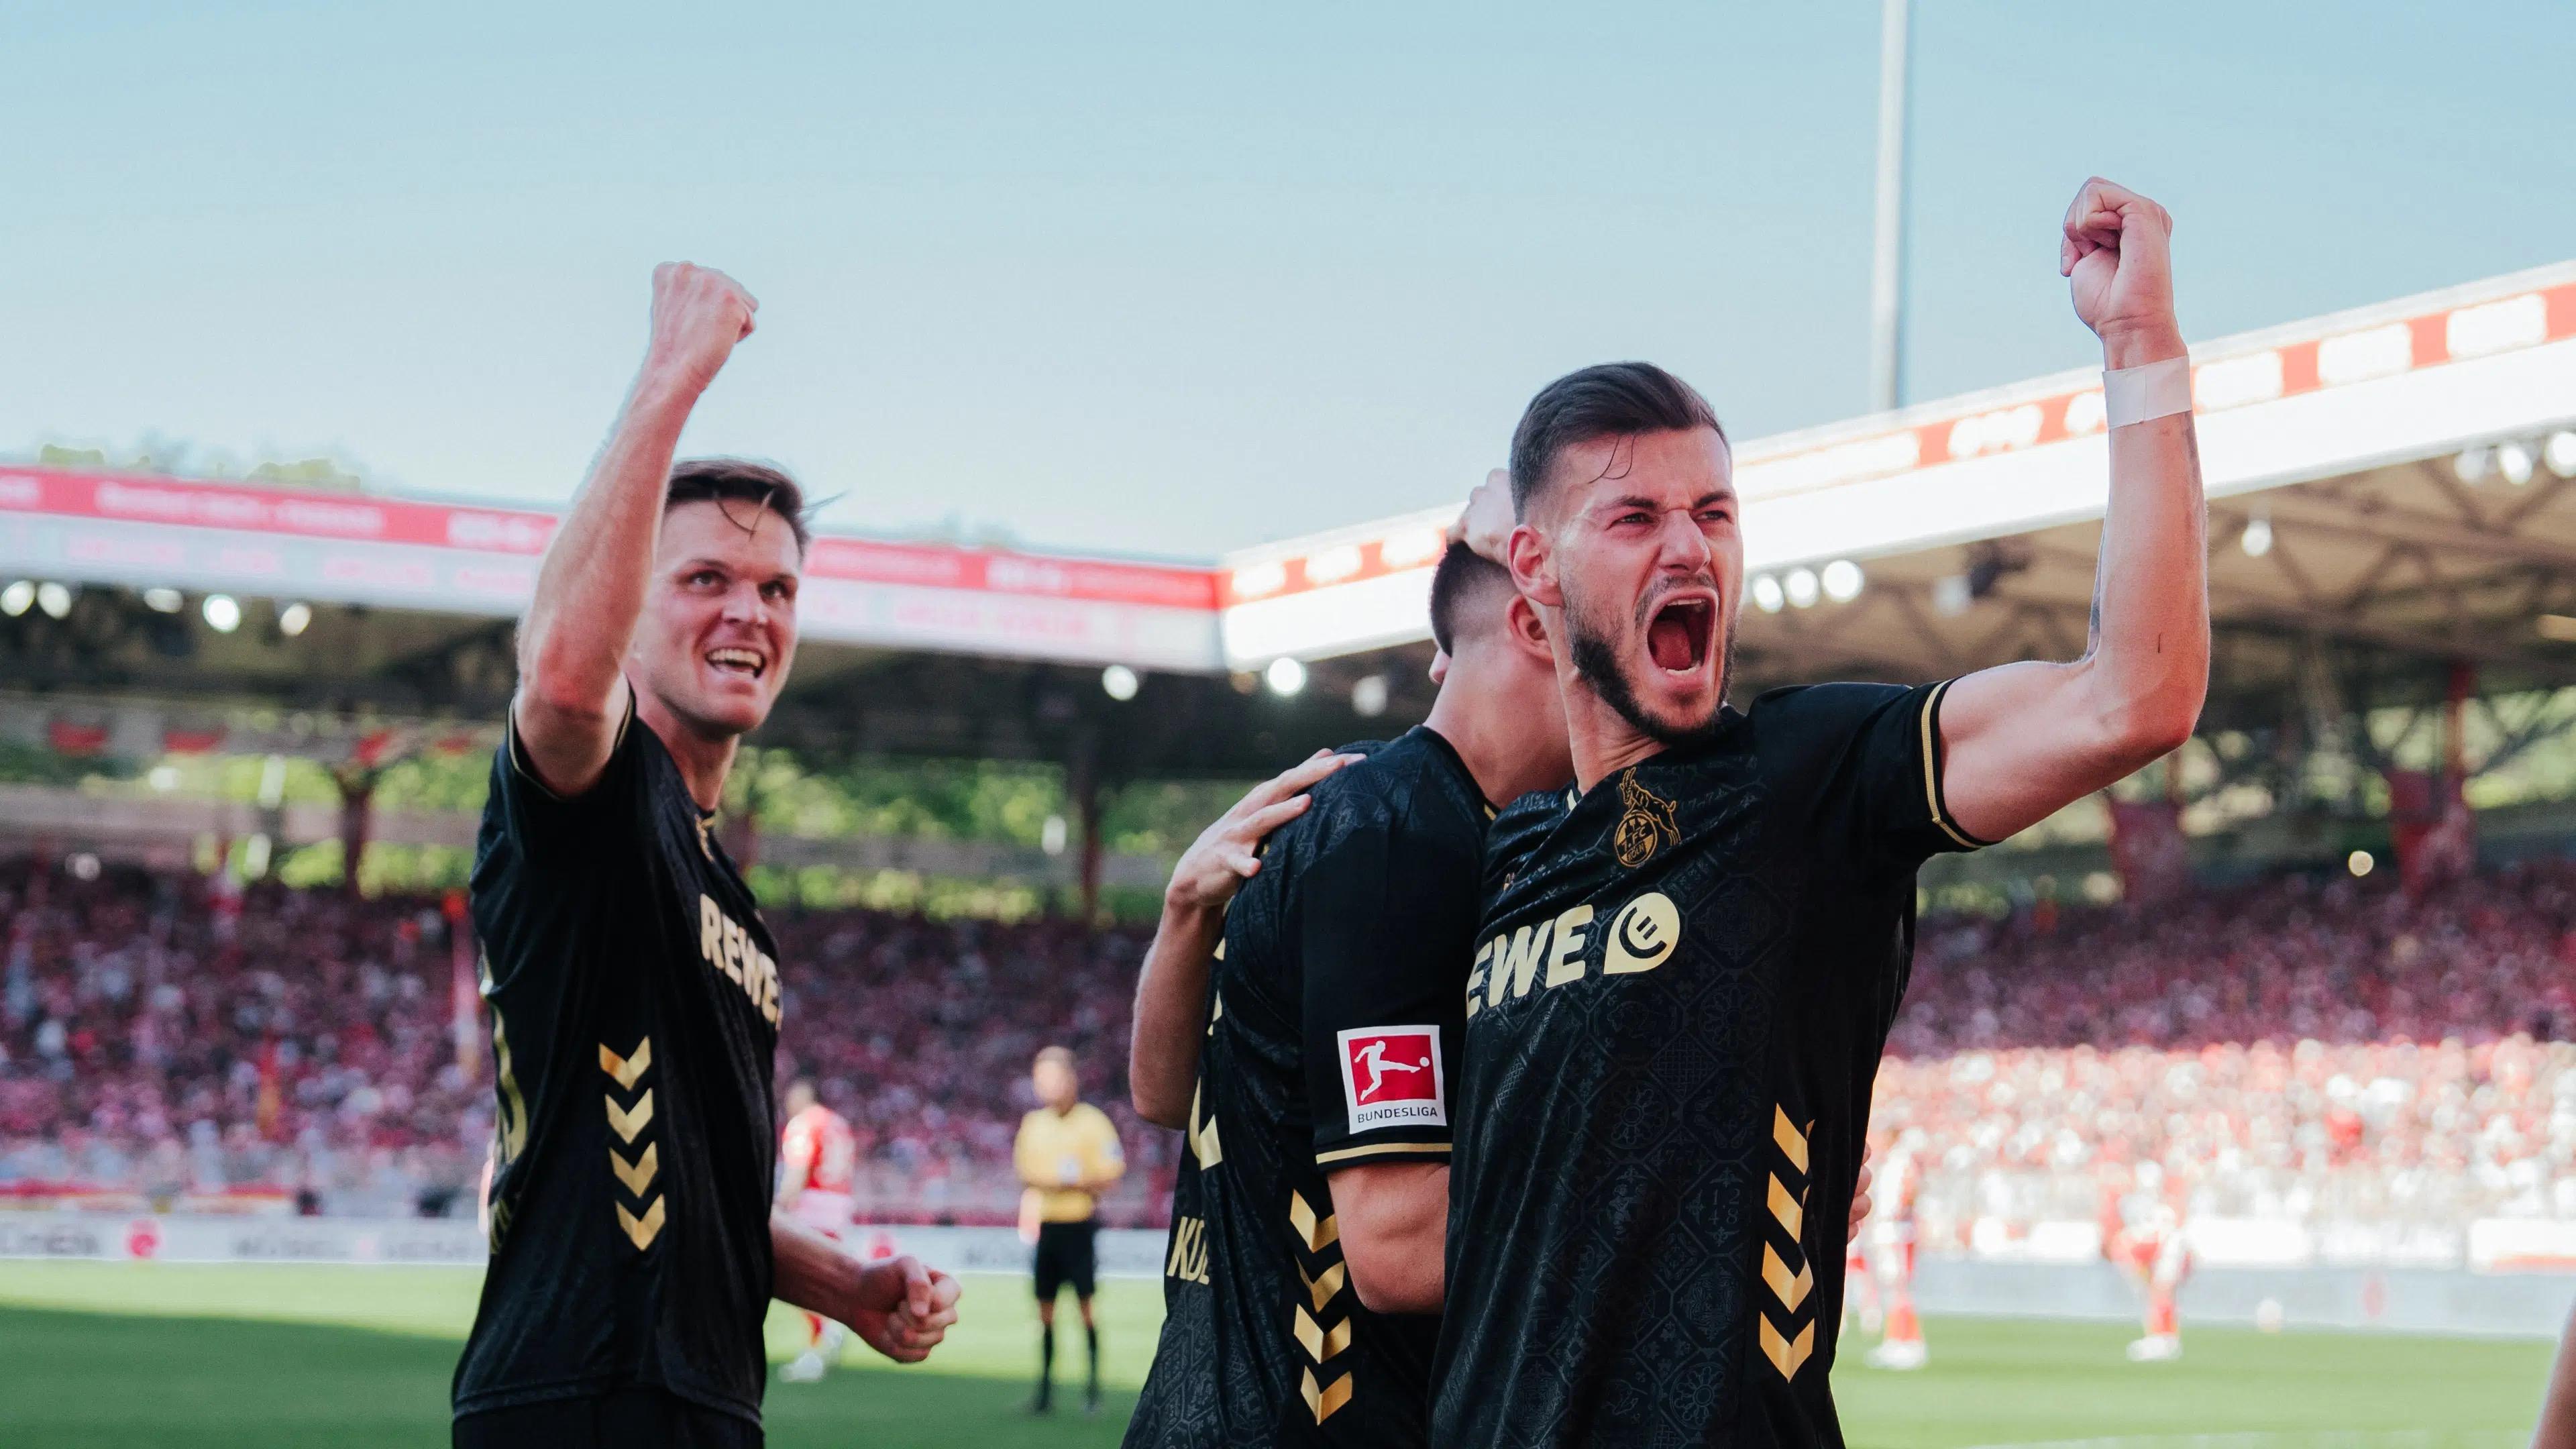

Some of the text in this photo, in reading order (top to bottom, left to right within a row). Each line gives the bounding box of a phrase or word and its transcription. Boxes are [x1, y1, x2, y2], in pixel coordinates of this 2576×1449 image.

[700, 893, 779, 1024] REWE
[1466, 904, 1594, 1020] EWE
[1357, 1106, 1438, 1124] BUNDESLIGA
